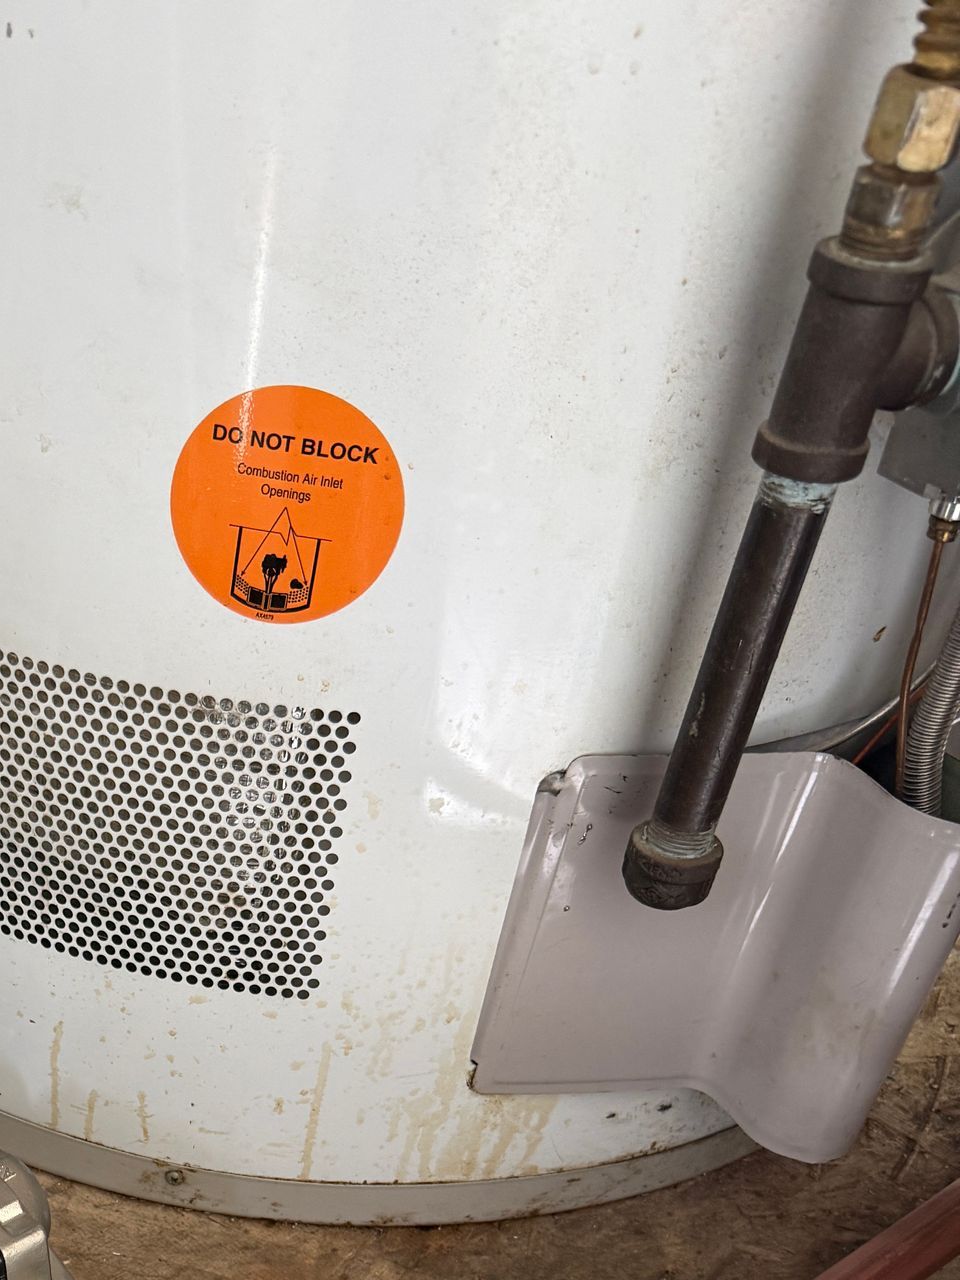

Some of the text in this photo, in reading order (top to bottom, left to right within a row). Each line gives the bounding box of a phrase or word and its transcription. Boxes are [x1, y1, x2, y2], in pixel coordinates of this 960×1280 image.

[212, 424, 380, 465] DO NOT BLOCK
[237, 463, 344, 490] Combustion Air Inlet
[260, 484, 311, 503] Openings
